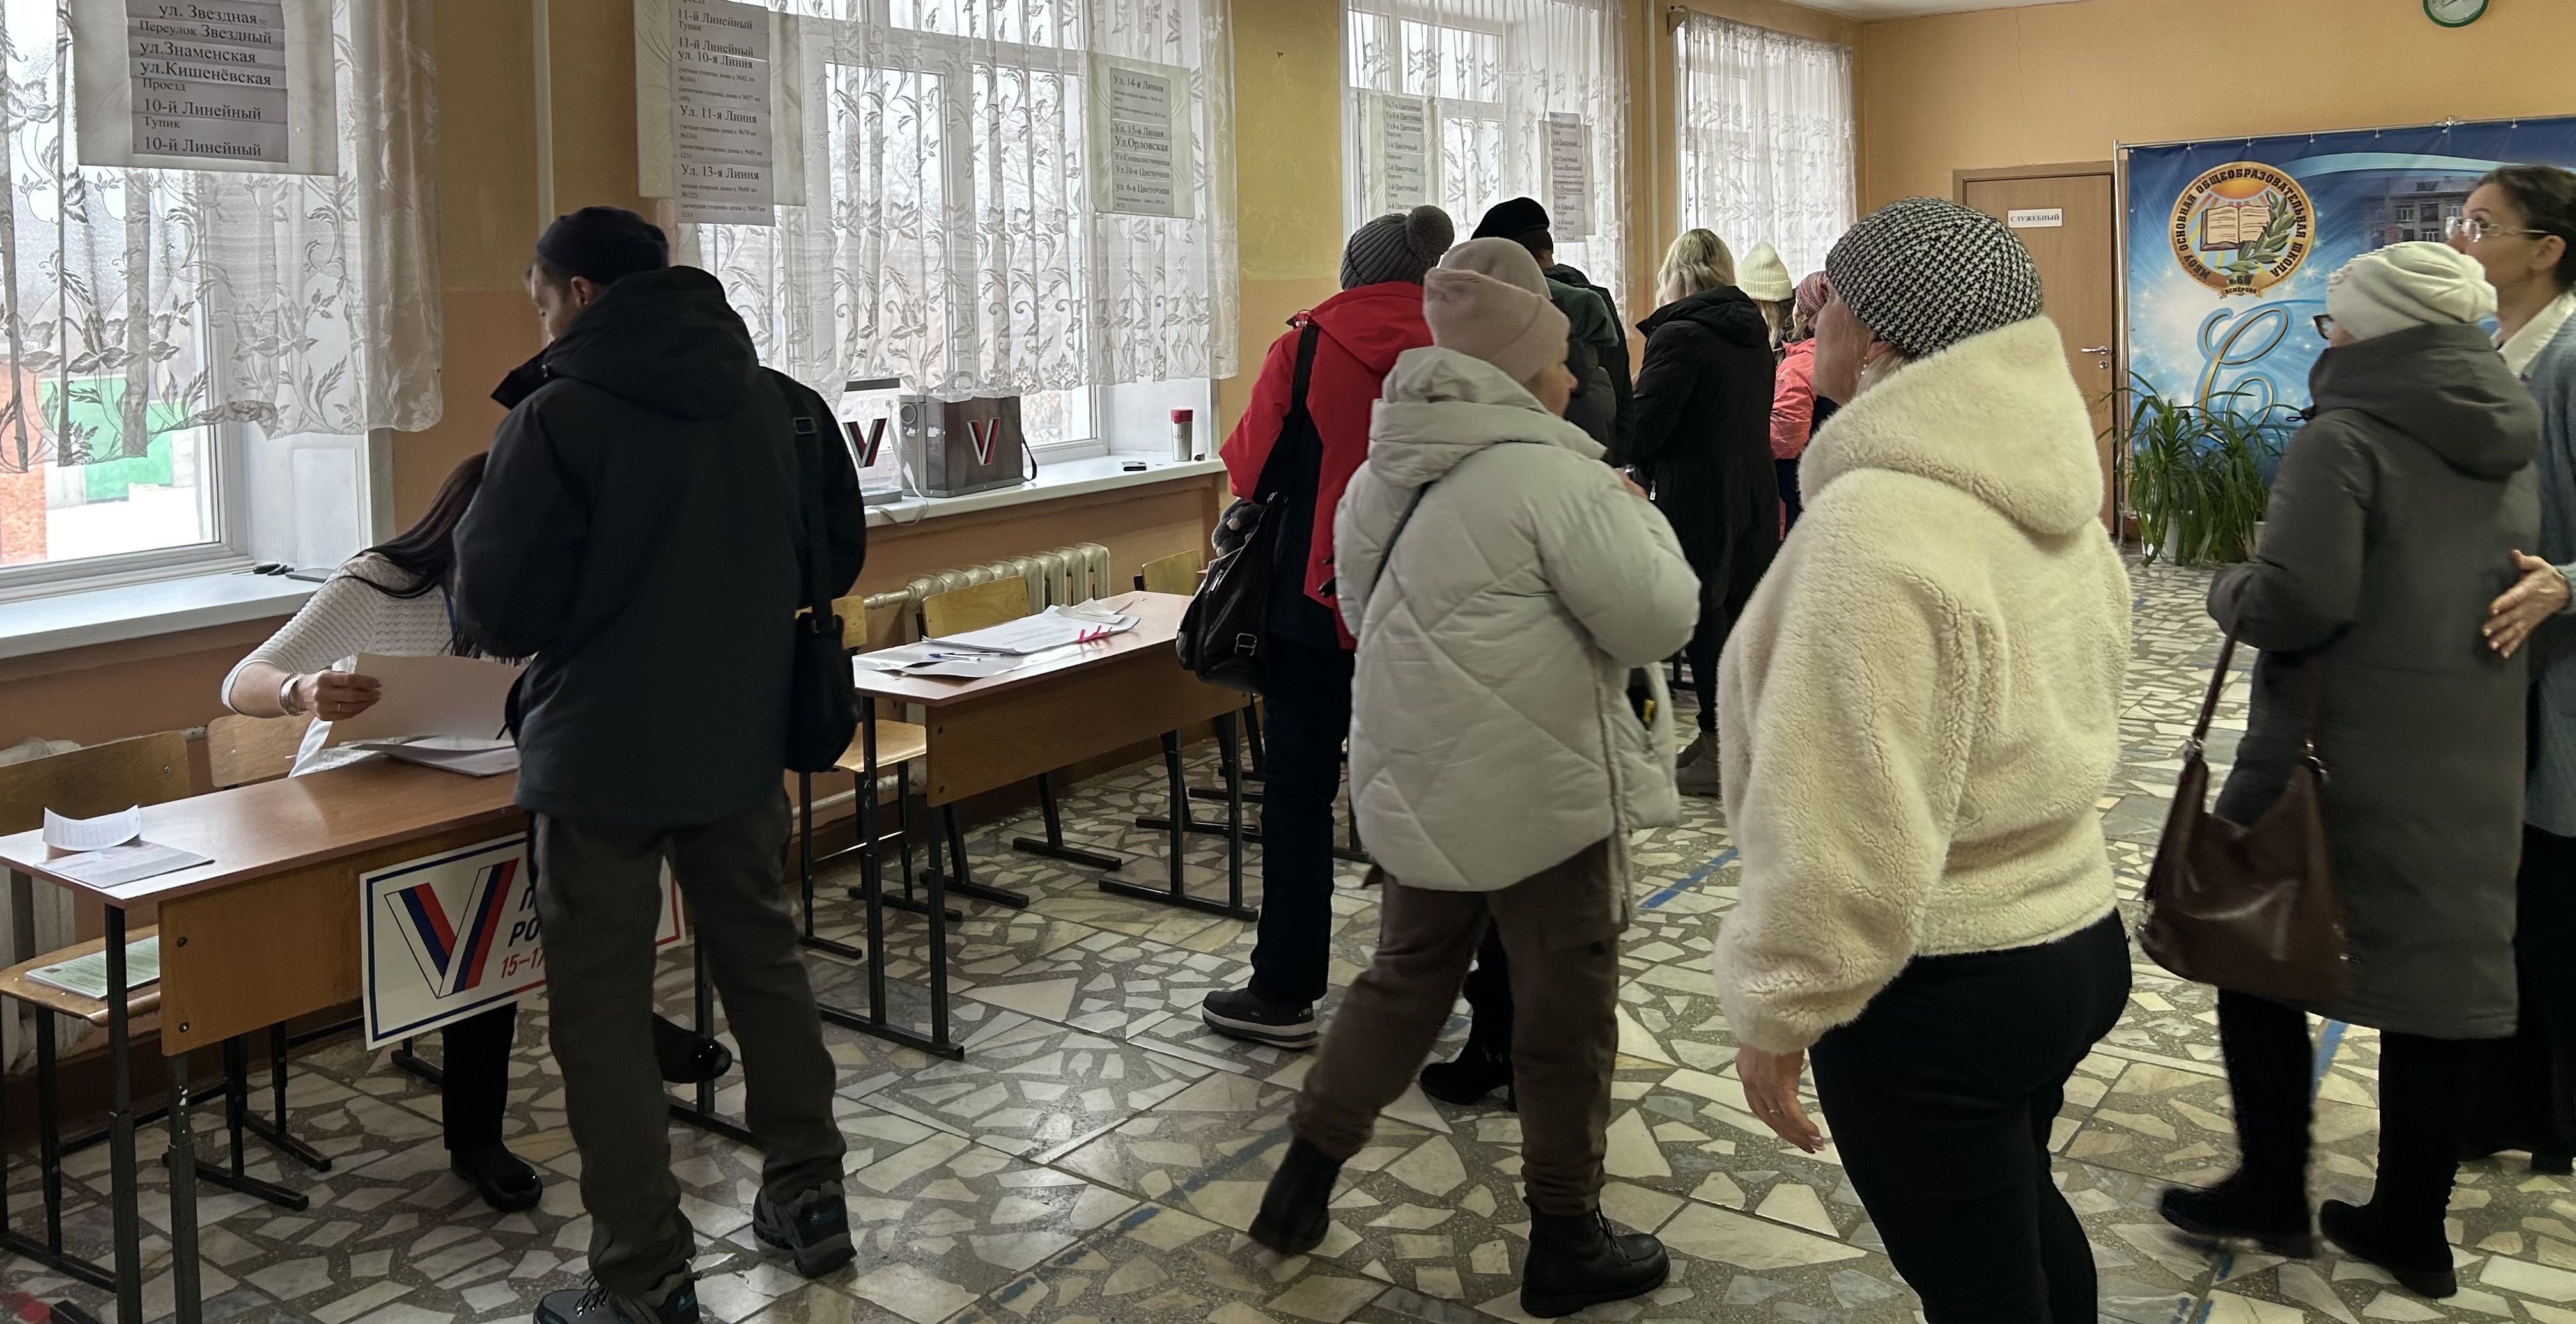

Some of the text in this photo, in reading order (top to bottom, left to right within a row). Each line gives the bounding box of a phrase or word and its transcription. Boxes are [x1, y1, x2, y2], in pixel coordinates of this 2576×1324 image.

[159, 4, 257, 24] ул. Звездная
[678, 8, 753, 30] 11-й Линейный
[139, 20, 272, 44] Переулок Звездный
[678, 20, 702, 31] Тупик
[139, 41, 256, 63] ул.Знаменская
[679, 36, 754, 57] 11-й Линейный
[678, 51, 753, 70] ул. 10-я Линия
[141, 61, 271, 86] ул.Кишенёвская
[143, 77, 186, 92] Проезд
[1113, 74, 1163, 93] Ул. 14-я Линия
[144, 98, 261, 120] 10-й Линейный
[679, 105, 757, 124] Ул. 11-я Линия
[143, 116, 181, 129] Тупик
[1114, 123, 1164, 137] Ул. 15-я Линия
[145, 137, 261, 156] 10-й Линейный
[1115, 136, 1168, 152] Ул.Орловская
[681, 164, 759, 180] Ул. 13-я Линия
[1139, 168, 1170, 178] Цветочная
[1137, 184, 1170, 194] Цветочная
[2176, 169, 2307, 279] МБОУ ОСНОВНАЯ ОБЩЕОБРАЗОВАТЕЛЬНАЯ ШКОЛА
